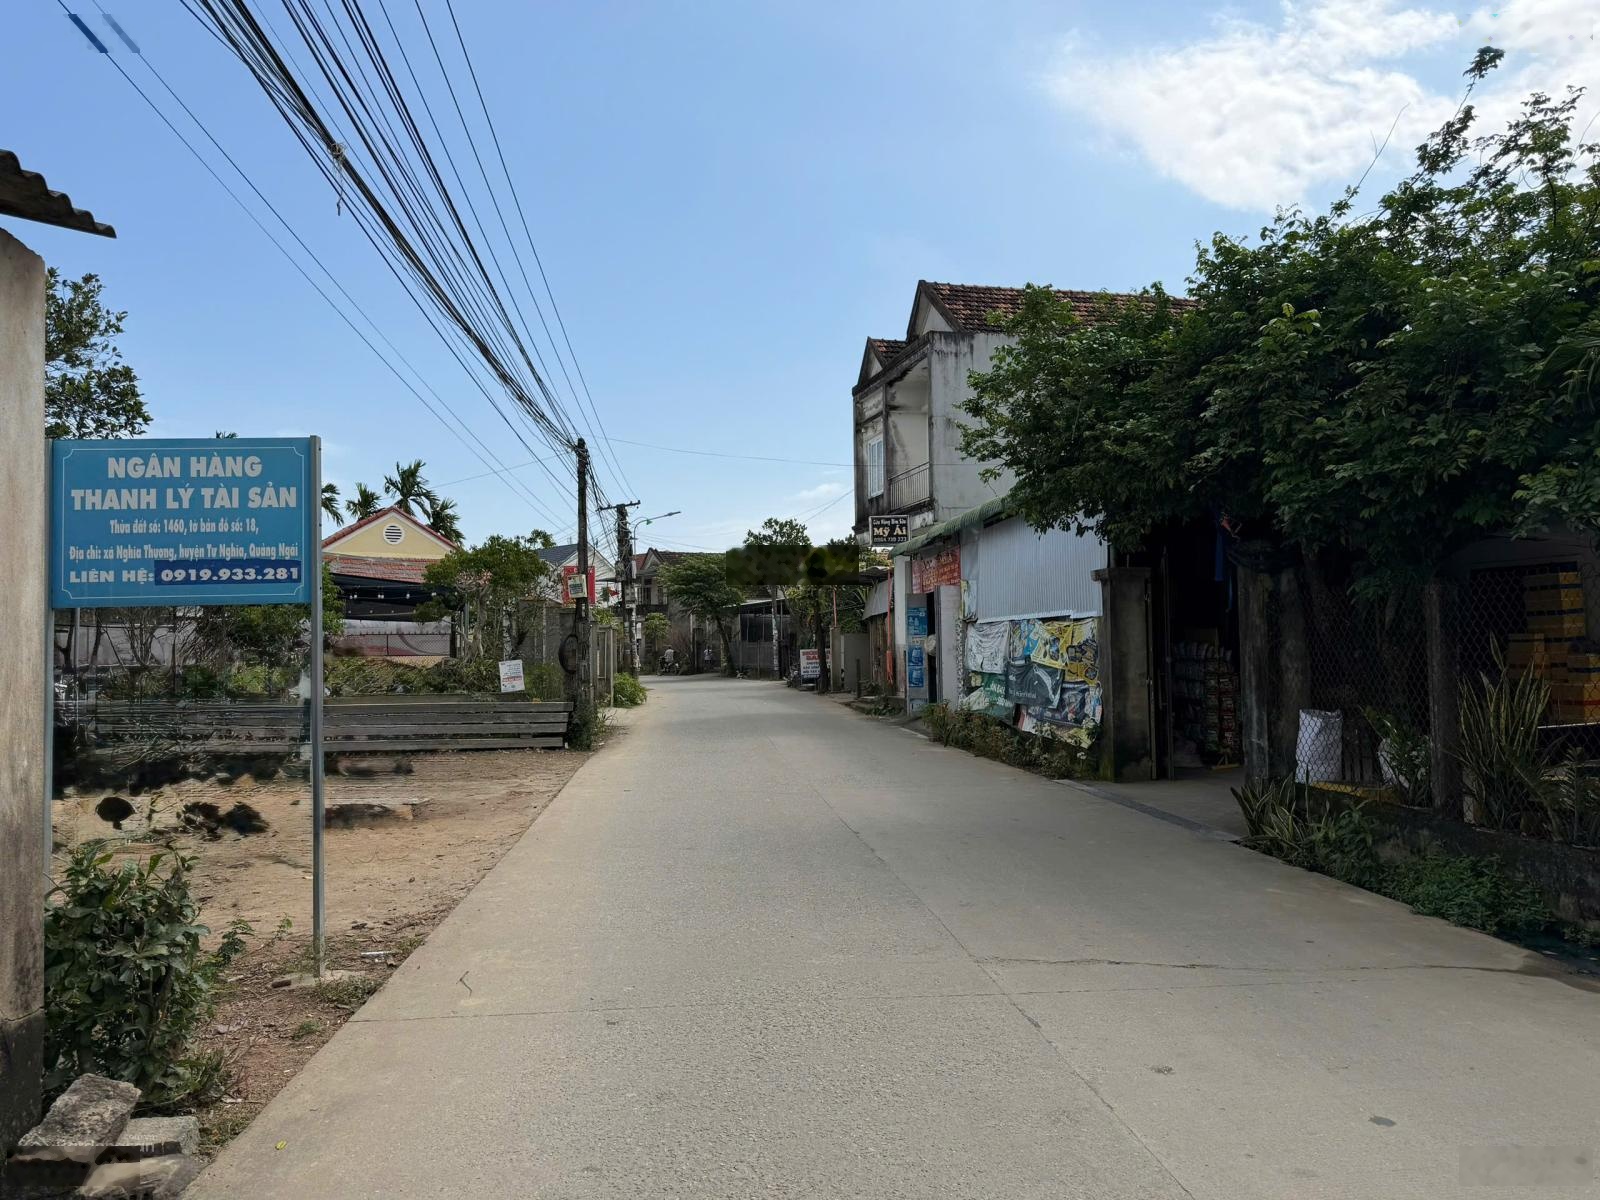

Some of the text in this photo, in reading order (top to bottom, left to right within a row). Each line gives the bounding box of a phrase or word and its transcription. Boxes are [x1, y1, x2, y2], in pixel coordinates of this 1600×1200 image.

[107, 452, 262, 478] NGÂN HÀNG
[71, 481, 297, 510] THANH LÝ TÀI SẢN
[164, 519, 187, 535] 1460,
[246, 518, 259, 534] 18,
[69, 546, 84, 563] Địa
[69, 568, 299, 584] LIÊN HỆ: 0919.933.281
